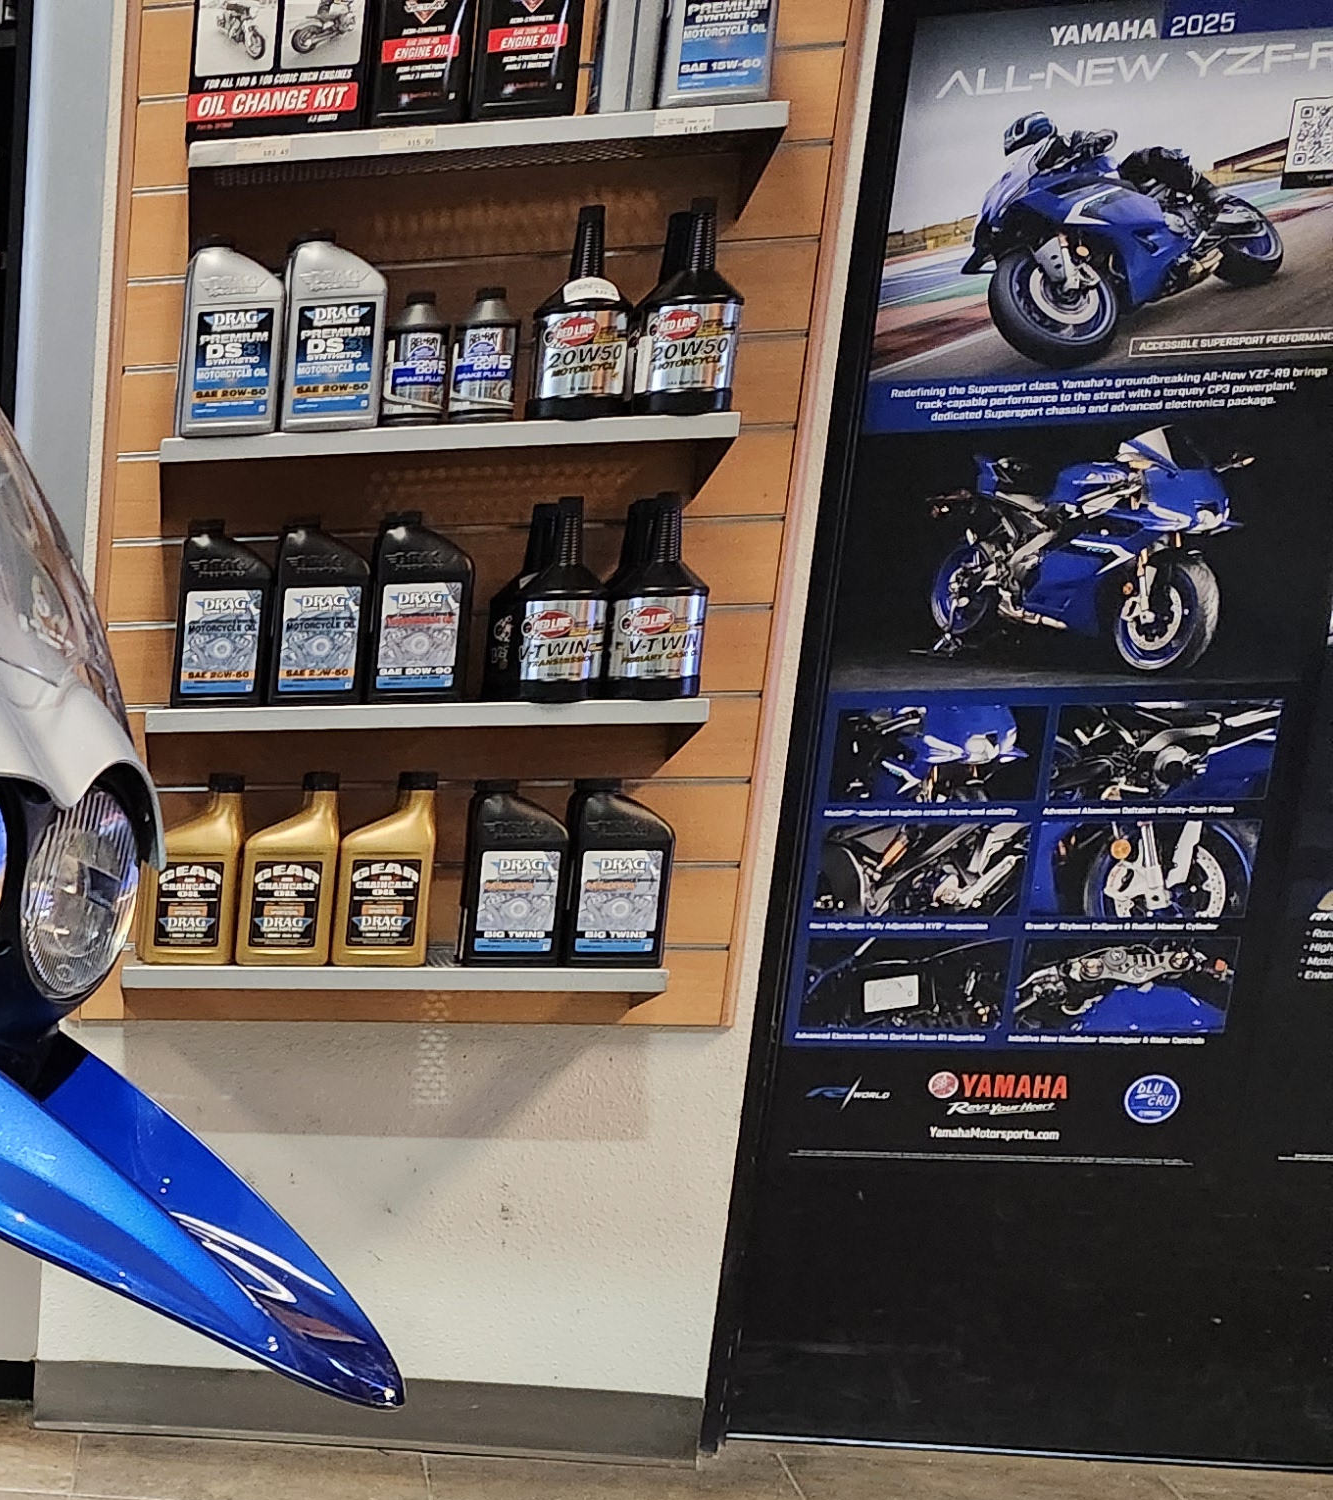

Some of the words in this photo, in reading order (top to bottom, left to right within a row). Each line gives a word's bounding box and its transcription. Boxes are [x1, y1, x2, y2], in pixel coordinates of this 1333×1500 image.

[683, 25, 749, 39] MOTORCYCLE
[751, 24, 767, 33] OIL
[1050, 18, 1157, 46] YAMAHA
[1170, 12, 1236, 37] 2025
[501, 35, 539, 49] ENGINE
[541, 32, 558, 46] OIL
[394, 45, 431, 60] ENGINE
[434, 44, 451, 56] OIL
[681, 63, 708, 73] SAE
[221, 78, 233, 88] ALL
[320, 68, 353, 81] ENGINES
[935, 52, 1169, 99] ALL-NEW
[197, 95, 226, 117] OIL
[231, 88, 311, 115] CHANGE
[314, 86, 349, 108] KIT
[213, 311, 258, 326] DRAG
[314, 305, 360, 320] DRAG
[556, 325, 573, 338] RED
[574, 322, 596, 335] LINE
[659, 320, 681, 332] RED
[683, 316, 699, 329] LINE
[200, 331, 269, 345] PREMIUM
[301, 326, 371, 340] PREMIUM
[1139, 338, 1198, 351] ACCESSIBLE
[1200, 335, 1265, 348] SUPERSPORT
[548, 345, 622, 369] 20W50
[651, 338, 729, 363] 20W50
[196, 368, 253, 381] MOTORCYCLE
[253, 367, 268, 377] OIL
[297, 363, 355, 376] MOTORCYCLE
[356, 362, 370, 372] OIL
[891, 386, 946, 399] Redefining
[948, 385, 966, 395] the
[968, 383, 1027, 396] Supersport
[1062, 377, 1112, 389] Yamaha's
[1115, 373, 1200, 388] groundbreaking
[1202, 371, 1246, 382] All-New
[1248, 369, 1290, 379] YZF-R9
[1292, 366, 1328, 378] brings
[195, 390, 218, 399] SAE
[296, 386, 320, 394] SAE
[916, 398, 988, 410] track-capable
[989, 394, 1059, 407] performance
[1060, 393, 1071, 401] to
[1073, 392, 1091, 401] the
[1093, 389, 1125, 400] street
[1128, 388, 1151, 398] with
[1207, 384, 1230, 394] CP3
[1232, 382, 1297, 394] powerplant,
[931, 411, 982, 422] dedicated
[984, 407, 1044, 419] Supersport
[1045, 404, 1086, 416] chassis
[1088, 404, 1109, 414] and
[1110, 401, 1163, 412] advanced
[1165, 399, 1225, 410] electronics
[203, 599, 246, 612] DRAG
[302, 595, 346, 608] DRAG
[398, 592, 442, 606] DRAG
[188, 622, 241, 633] MOTORCYCLE
[286, 621, 340, 632] MOTORCYCLE
[534, 619, 550, 630] RED
[551, 617, 572, 628] LINE
[633, 617, 649, 628] RED
[650, 613, 672, 625] LINE
[629, 634, 698, 655] V-TWIN
[499, 859, 544, 871] DRAG
[601, 858, 646, 870] DRAG
[159, 865, 222, 885] GEAR
[254, 864, 320, 884] GEAR
[352, 862, 420, 883] GEAR
[177, 890, 201, 898] OIL
[273, 889, 298, 898] OIL
[371, 888, 397, 896] OIL
[167, 917, 207, 930] DRAG
[263, 917, 304, 929] DRAG
[361, 916, 402, 928] DRAG
[508, 931, 545, 939] TWINS
[609, 930, 647, 938] TWINS
[961, 1075, 1068, 1099] YAMAHA
[946, 1102, 990, 1116] Revs
[991, 1102, 1022, 1114] Your
[929, 1126, 1060, 1141] YamahaMotorsports.com
